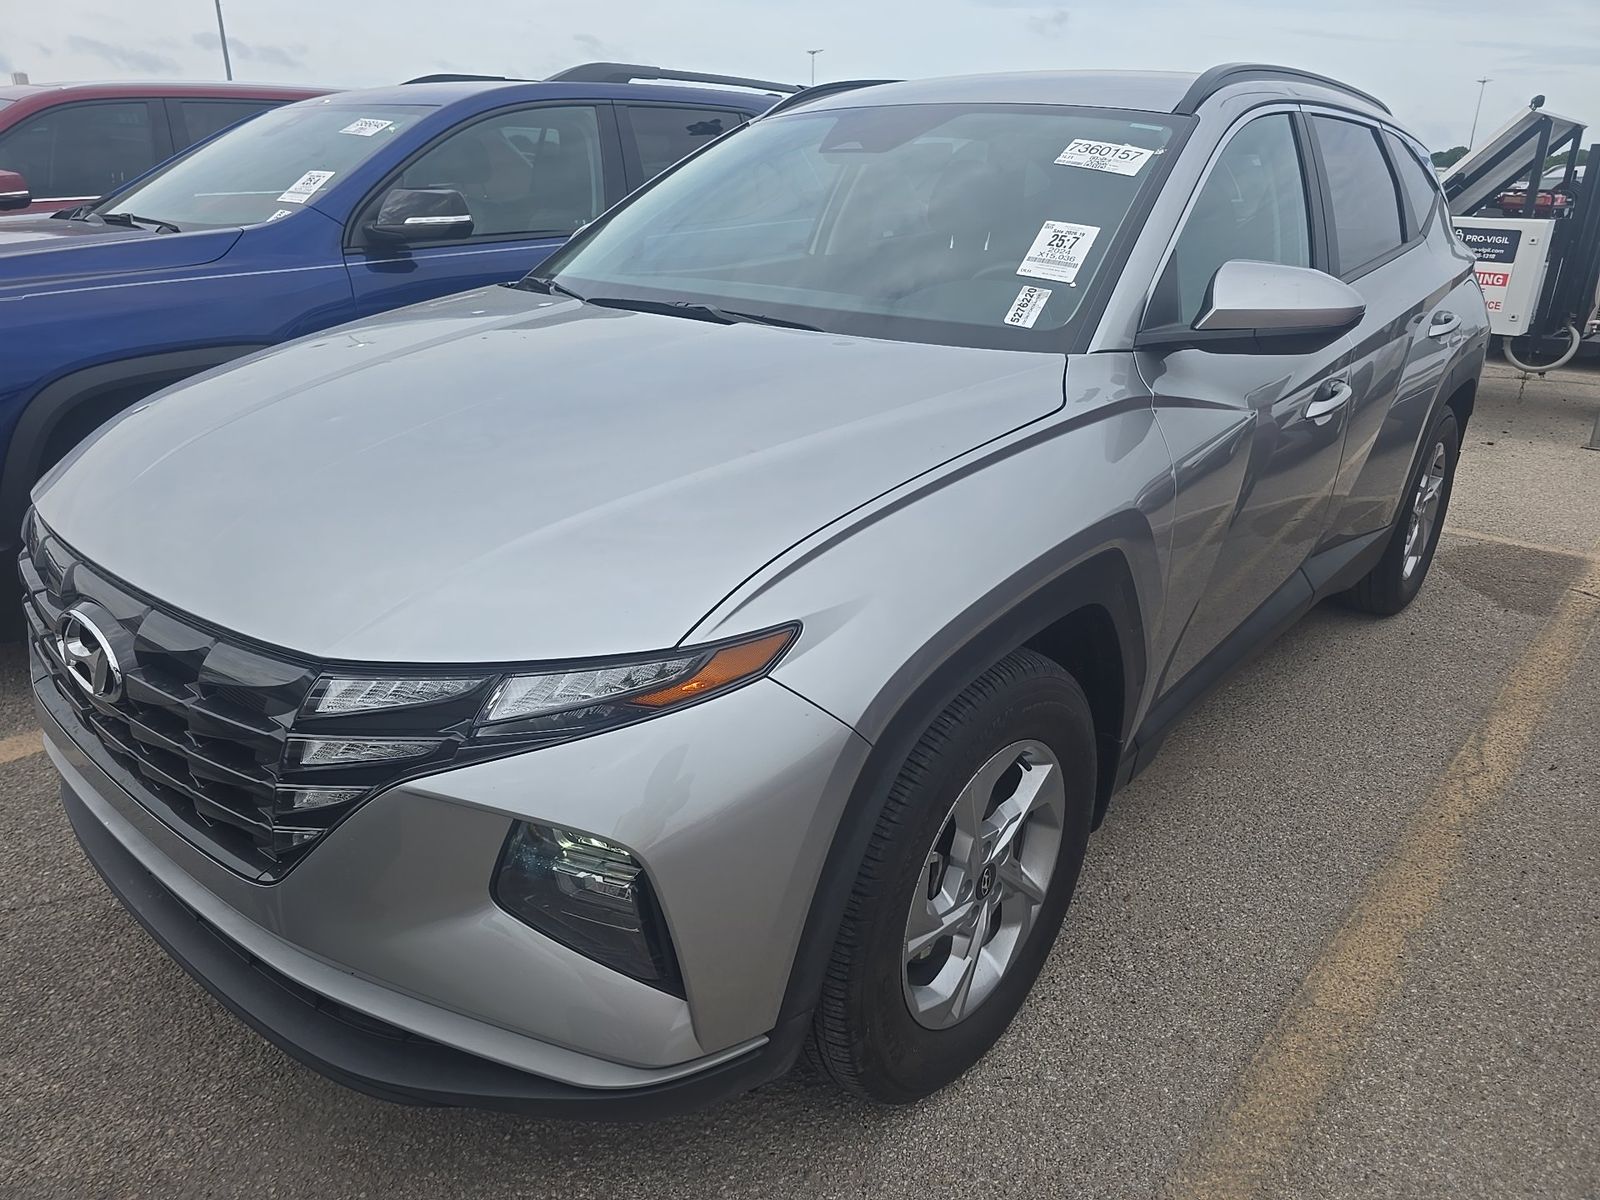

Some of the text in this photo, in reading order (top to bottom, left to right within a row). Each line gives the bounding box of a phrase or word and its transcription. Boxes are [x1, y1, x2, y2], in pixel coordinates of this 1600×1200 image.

[1068, 142, 1144, 161] 7360157
[1047, 233, 1080, 249] 25:7
[1465, 234, 1510, 244] PRO-VIGIL
[1047, 247, 1071, 255] 2024
[1010, 288, 1037, 323] 5276220
